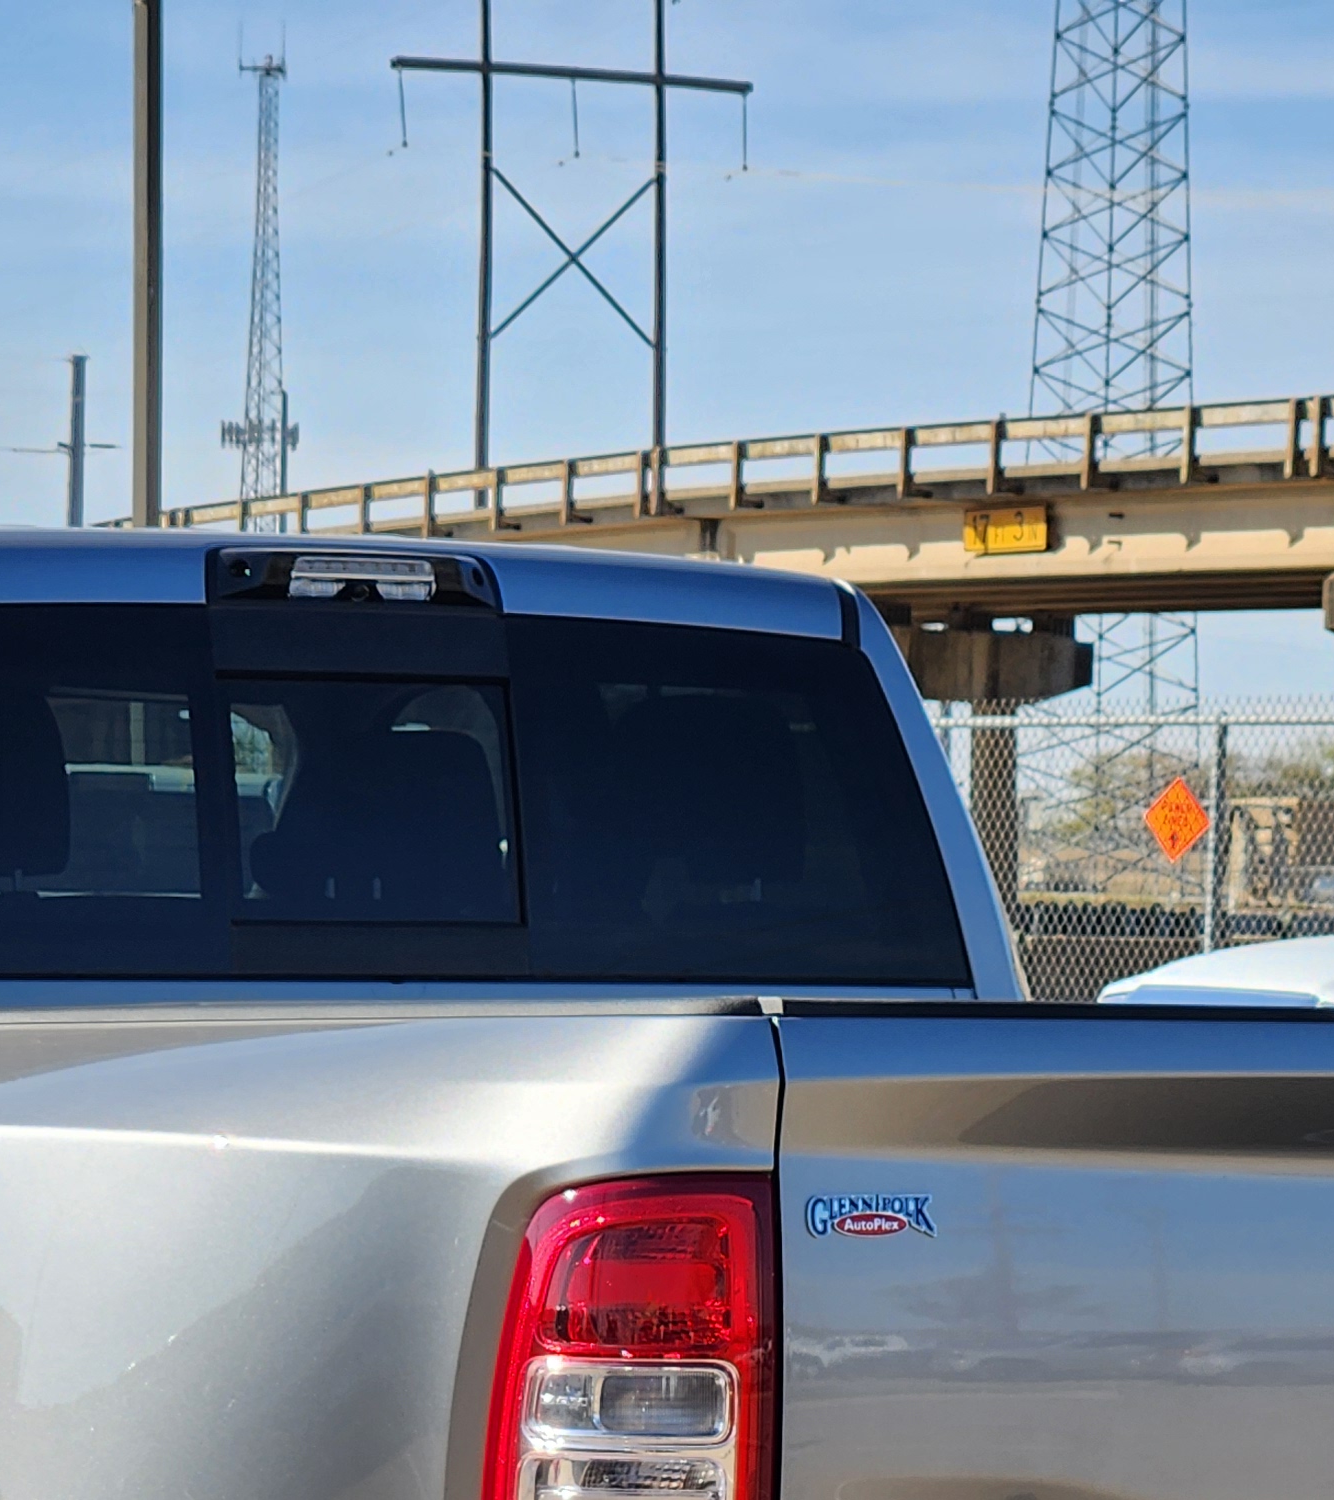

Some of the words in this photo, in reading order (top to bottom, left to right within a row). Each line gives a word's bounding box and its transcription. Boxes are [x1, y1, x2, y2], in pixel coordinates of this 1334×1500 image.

[810, 1197, 875, 1237] GLENN
[880, 1195, 936, 1237] POLK
[844, 1218, 900, 1232] AutoPlex
